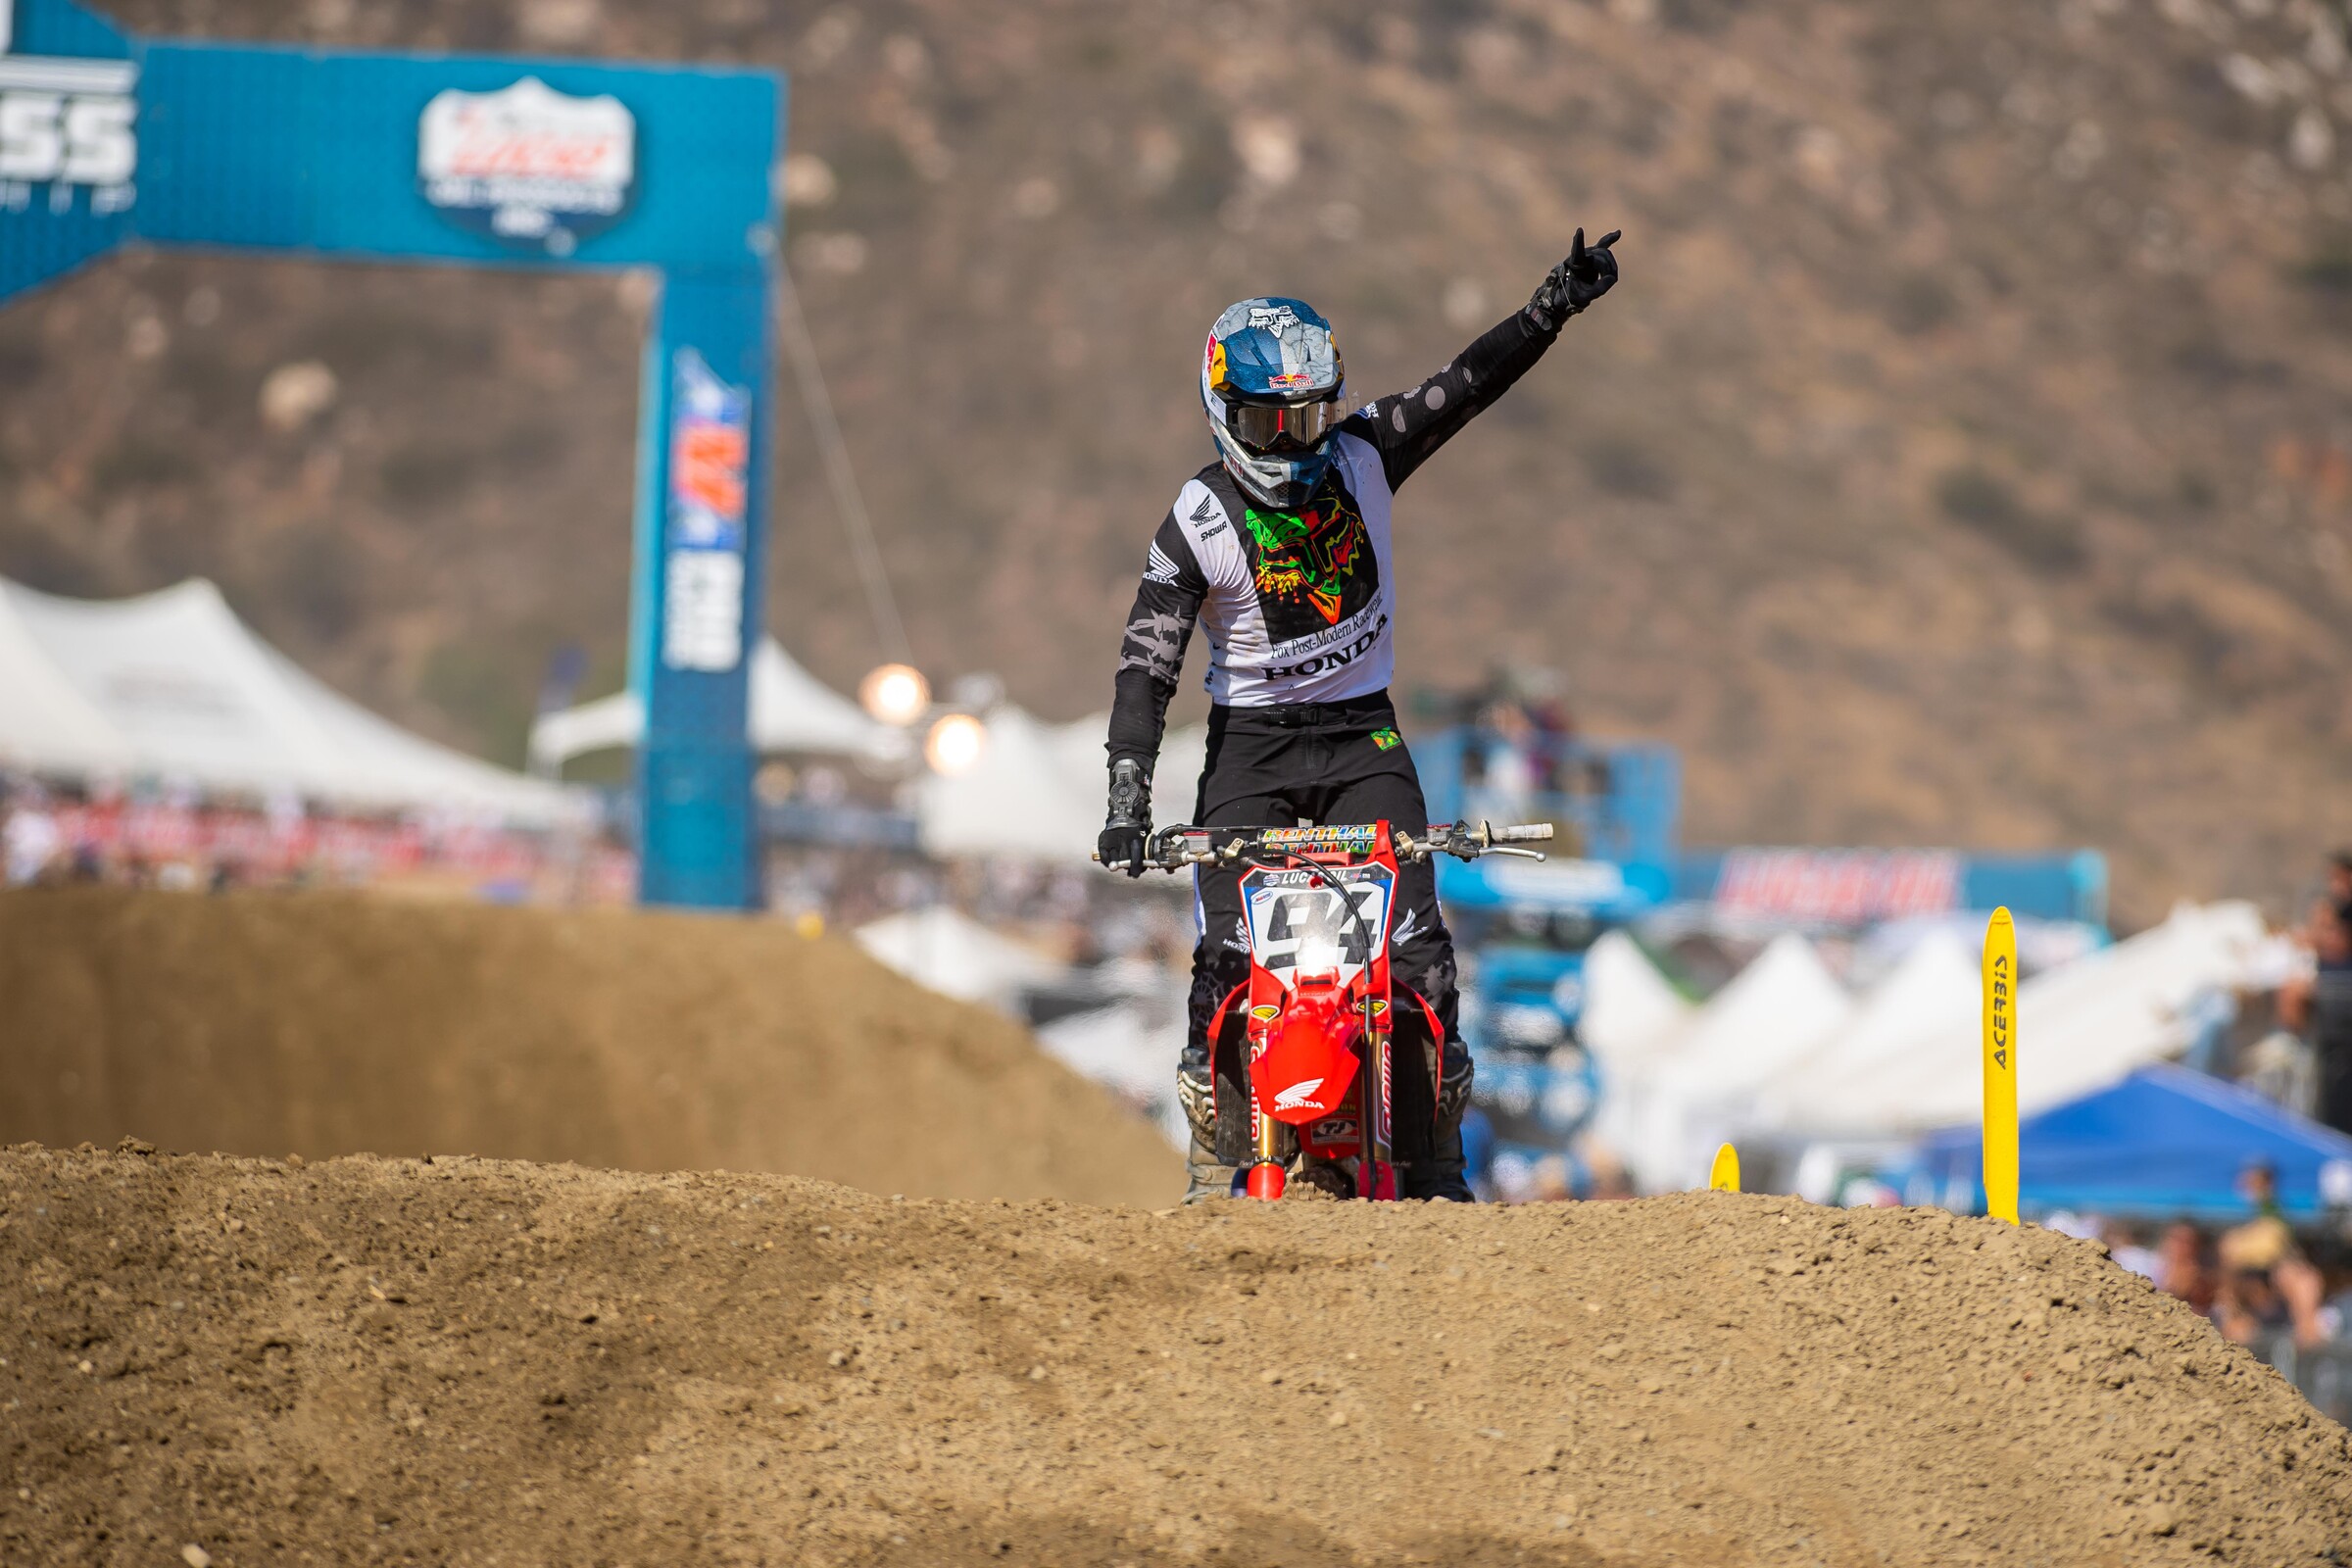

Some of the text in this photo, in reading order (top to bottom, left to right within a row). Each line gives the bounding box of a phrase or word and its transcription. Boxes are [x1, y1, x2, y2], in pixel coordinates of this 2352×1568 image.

[1194, 512, 1222, 528] HONDA
[1200, 520, 1227, 542] SHOWA
[1261, 613, 1389, 680] HONDA
[1270, 643, 1290, 659] Fox
[1292, 623, 1351, 656] Post-Modern
[1264, 892, 1377, 971] 94
[1274, 1101, 1325, 1112] HONDA
